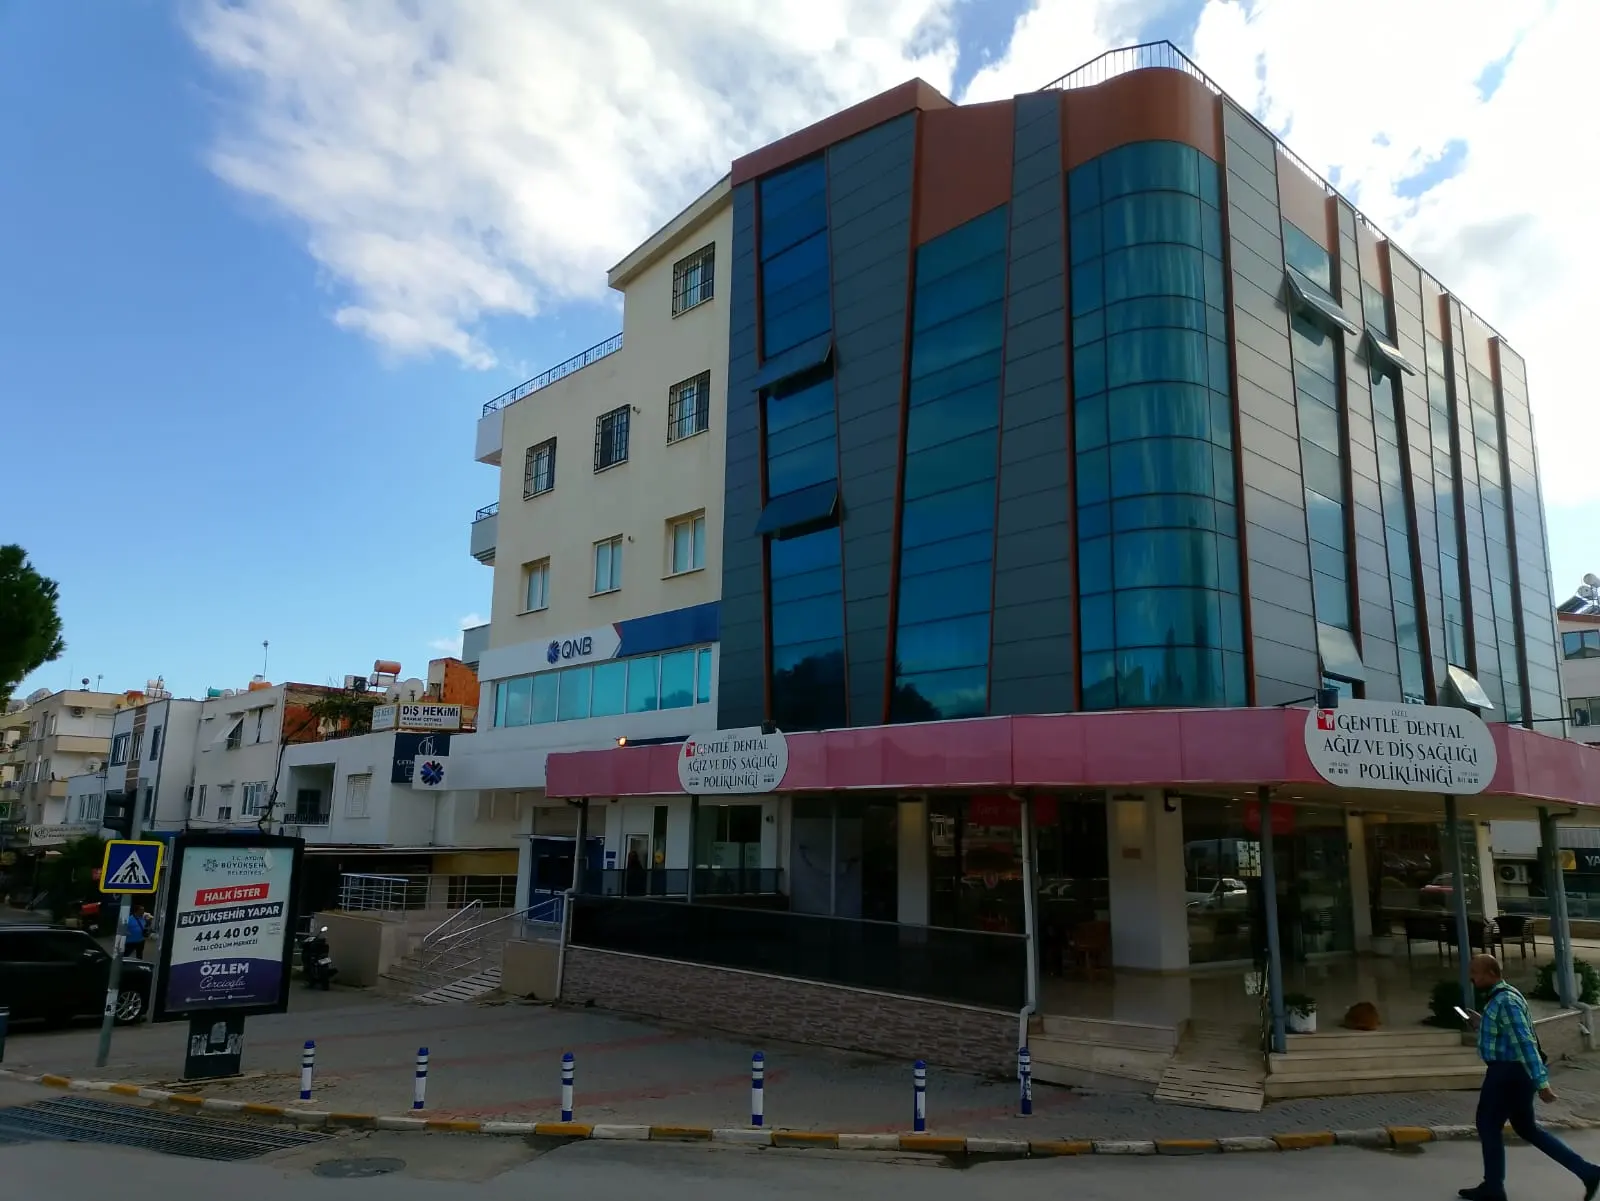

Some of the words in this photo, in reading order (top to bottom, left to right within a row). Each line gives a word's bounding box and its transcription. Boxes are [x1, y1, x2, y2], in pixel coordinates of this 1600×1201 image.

[562, 636, 612, 659] QNB
[1338, 714, 1399, 733] GENTLE
[1406, 720, 1464, 739] DENTAL
[697, 740, 729, 756] GENTLE
[734, 739, 768, 751] DENTAL
[1323, 735, 1361, 756] AĞIZ
[1364, 740, 1384, 755] VE
[1388, 739, 1414, 763] DİŞ
[1417, 742, 1478, 765] SAĞLIĞI
[688, 759, 706, 773] AĞIZ
[710, 759, 720, 770] VE
[723, 755, 736, 773] DİŞ
[741, 753, 778, 770] SAĞLIĞI
[704, 772, 758, 789] POLİKLİNİĞİ
[1359, 762, 1453, 786] POLİKLİNİĞİ
[204, 891, 231, 902] HALK
[233, 888, 261, 899] İSTER
[181, 908, 245, 925] BÜYÜKŞEHİR
[248, 906, 279, 916] YAPAR
[195, 930, 220, 942] 444
[224, 928, 240, 938] 40
[244, 926, 259, 936] 09
[200, 962, 249, 975] ÖZLEM
